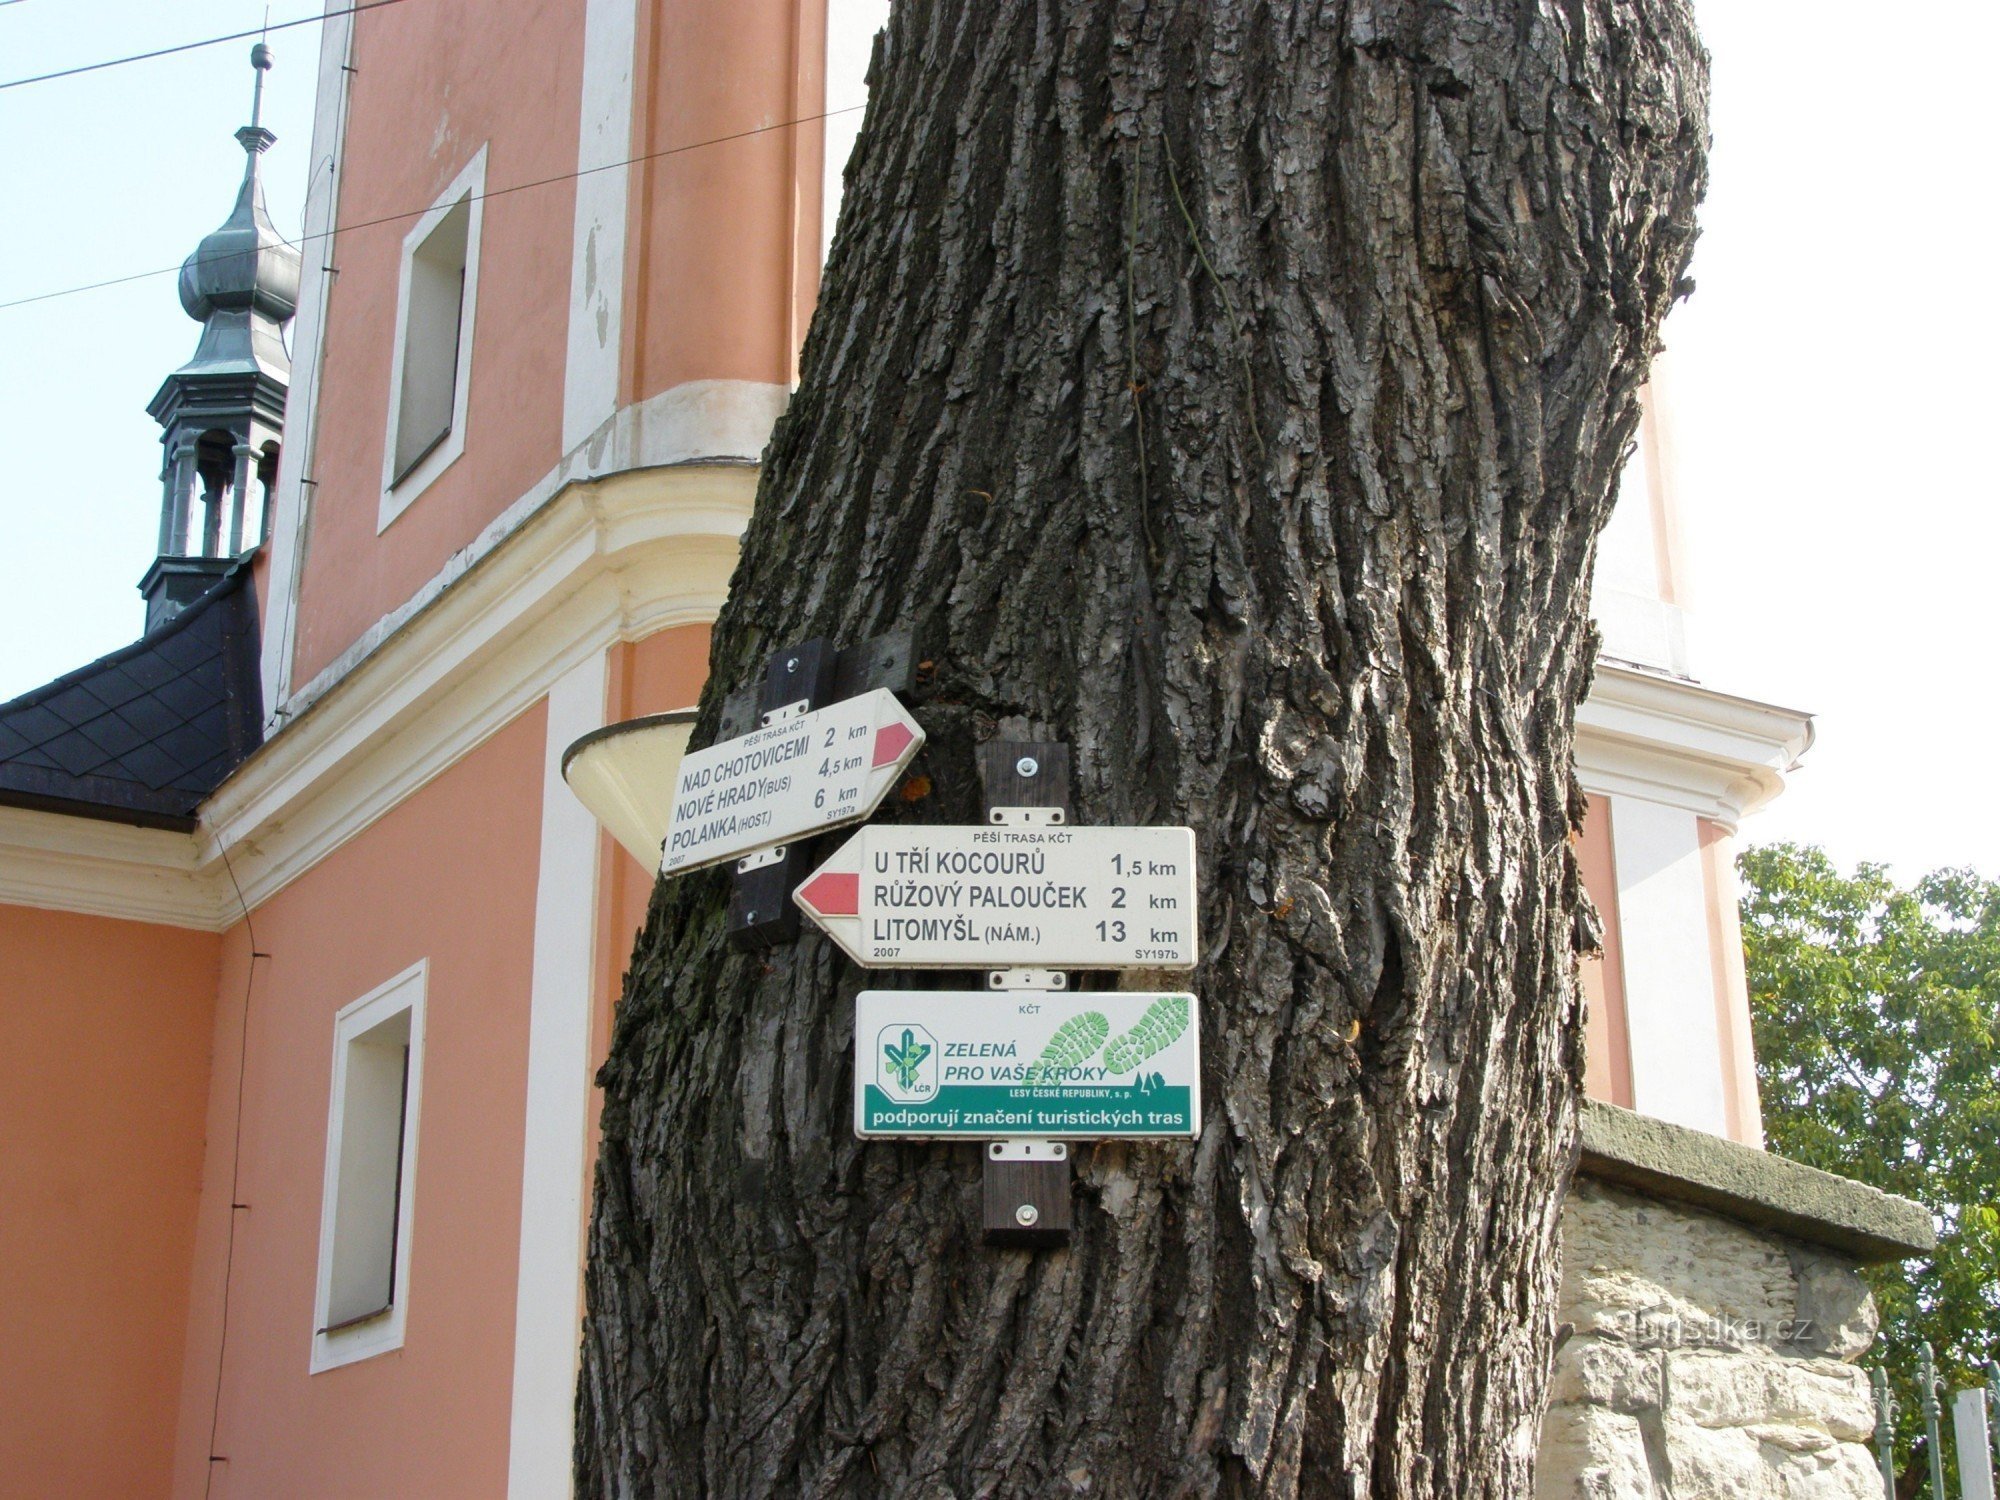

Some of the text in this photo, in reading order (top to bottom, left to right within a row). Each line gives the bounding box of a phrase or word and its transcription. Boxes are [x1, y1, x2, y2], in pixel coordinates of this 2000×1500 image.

[763, 727, 787, 741] TRASA
[789, 720, 806, 734] KČT
[824, 725, 867, 748] 2 km
[682, 735, 810, 793] NAD CHOTOVICEMI
[818, 756, 862, 778] 4,5 km
[676, 790, 715, 823] NOVÉ
[814, 787, 857, 809] 6 km
[827, 805, 855, 820] SY197a
[973, 832, 1073, 843] PĚŠÍ TRASA KČT
[669, 855, 686, 866] 2007
[875, 847, 1045, 874] U TŘÍ KOCOURŮ
[1111, 853, 1177, 878] 1,5 km
[874, 880, 1087, 909] RŮŽOVÝ PALOUČEK
[1111, 887, 1177, 910] 2 km
[873, 914, 1041, 944] LITOMYŠL (NÁM.)
[1095, 921, 1178, 943] 13 km
[874, 947, 900, 957] 2007
[1135, 949, 1179, 959] SY197b
[1018, 1004, 1041, 1014] KČT
[944, 1040, 1017, 1057] ZELENÁ
[944, 1062, 1109, 1081] PRO VAŠE KROKY
[914, 1082, 931, 1093] LČR
[1009, 1089, 1030, 1098] LESY
[1032, 1086, 1060, 1098] ČESKÉ
[873, 1109, 1183, 1128] podporují značení turistických tras
